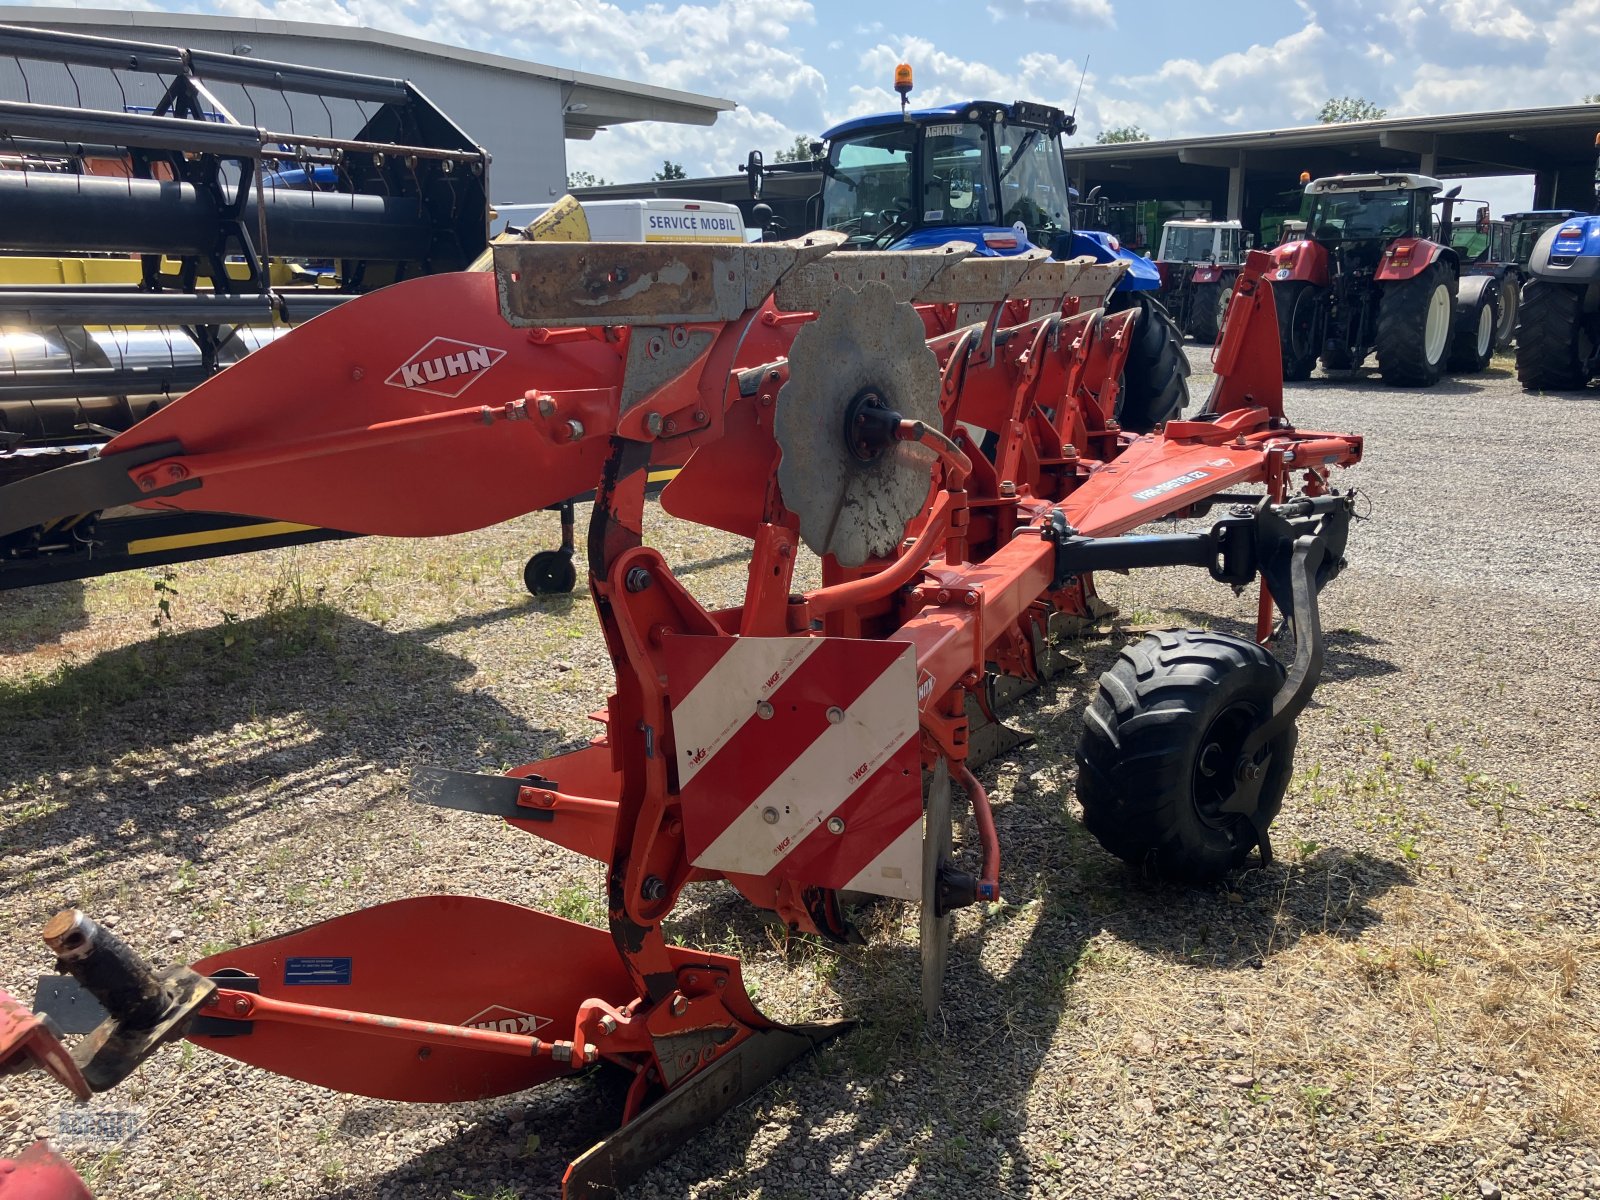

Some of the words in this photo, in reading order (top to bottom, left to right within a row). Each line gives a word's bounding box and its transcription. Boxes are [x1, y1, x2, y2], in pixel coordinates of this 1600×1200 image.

[925, 123, 962, 138] AGRATEC
[649, 215, 697, 229] SERVICE
[701, 217, 735, 230] MOBIL
[400, 347, 492, 388] KUHN
[765, 670, 781, 688] WGF
[918, 676, 934, 702] KUH
[692, 747, 707, 764] WGF
[853, 762, 869, 780] WGF
[776, 836, 791, 852] WGF
[468, 1016, 537, 1034] KUH
